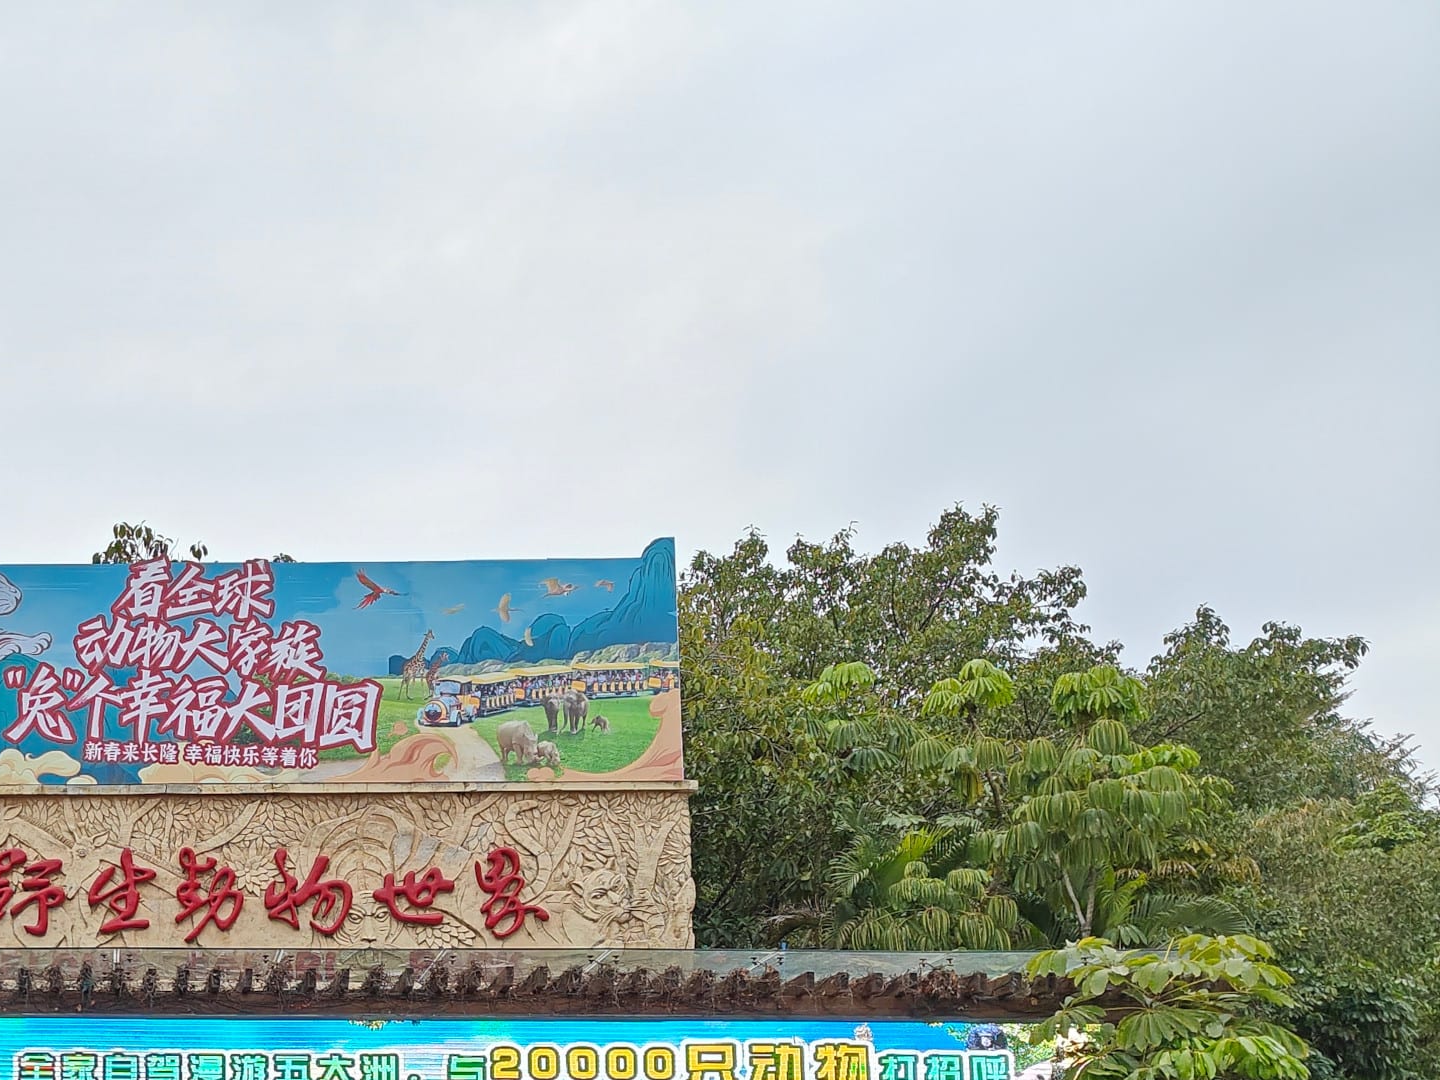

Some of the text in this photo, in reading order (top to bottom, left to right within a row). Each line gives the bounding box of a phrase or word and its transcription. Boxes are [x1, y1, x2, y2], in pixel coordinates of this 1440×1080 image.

[114, 555, 274, 619] 看全球
[74, 616, 327, 680] 动物大家族
[84, 741, 318, 768] 新春来长隆 幸福快乐等着你
